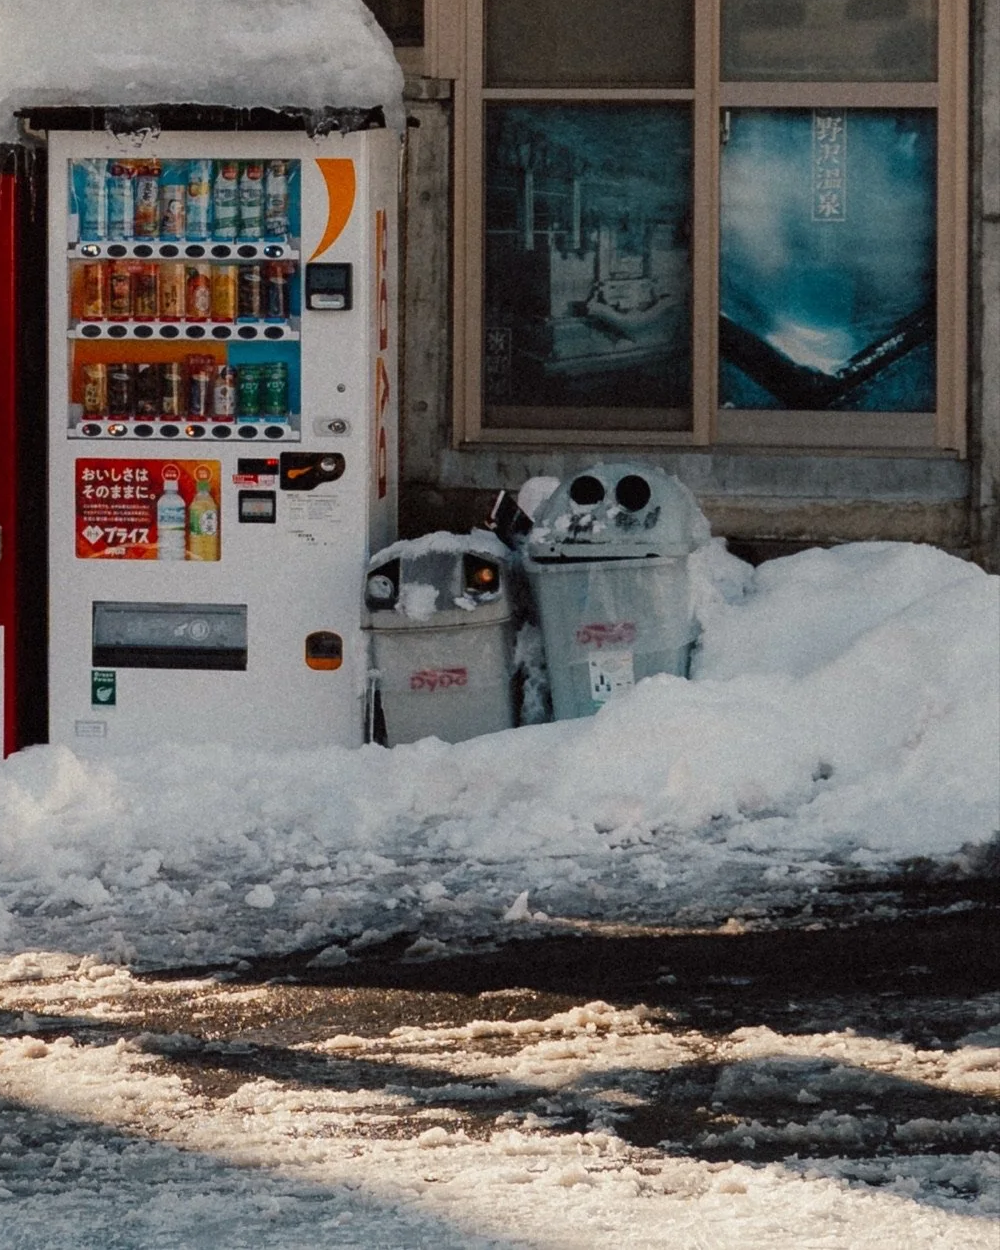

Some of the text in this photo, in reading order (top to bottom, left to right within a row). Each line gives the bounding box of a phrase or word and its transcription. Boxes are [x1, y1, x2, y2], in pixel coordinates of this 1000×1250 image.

[81, 467, 149, 482] おいしさは
[82, 484, 156, 500] そのままに。
